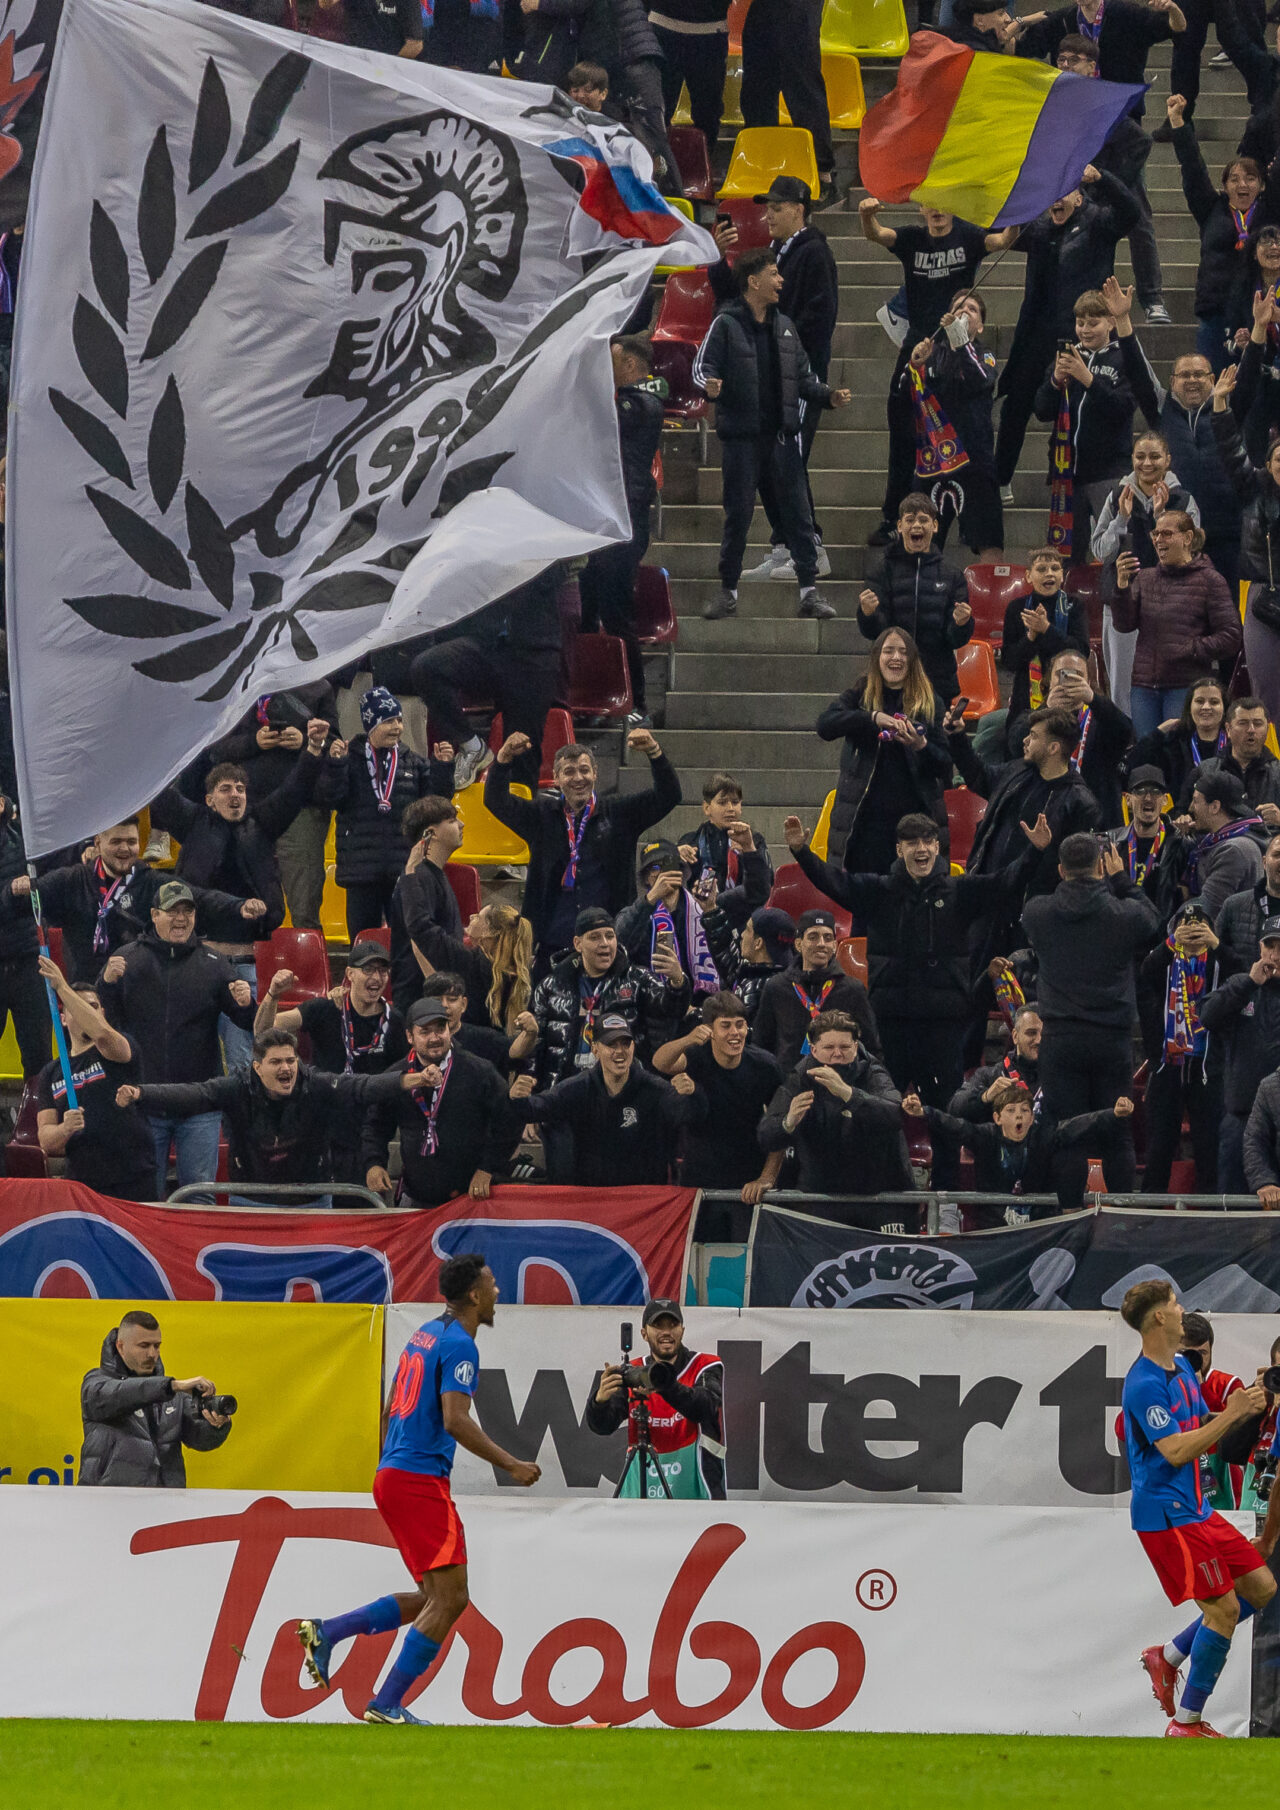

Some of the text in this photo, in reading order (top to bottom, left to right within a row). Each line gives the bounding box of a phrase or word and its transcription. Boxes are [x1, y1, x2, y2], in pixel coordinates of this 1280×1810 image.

[914, 246, 966, 269] ULTRAS
[880, 1223, 905, 1235] NIKE
[454, 1361, 475, 1386] MG
[472, 1340, 1023, 1493] wlter
[1146, 1405, 1171, 1429] MG
[1198, 1557, 1224, 1588] 11
